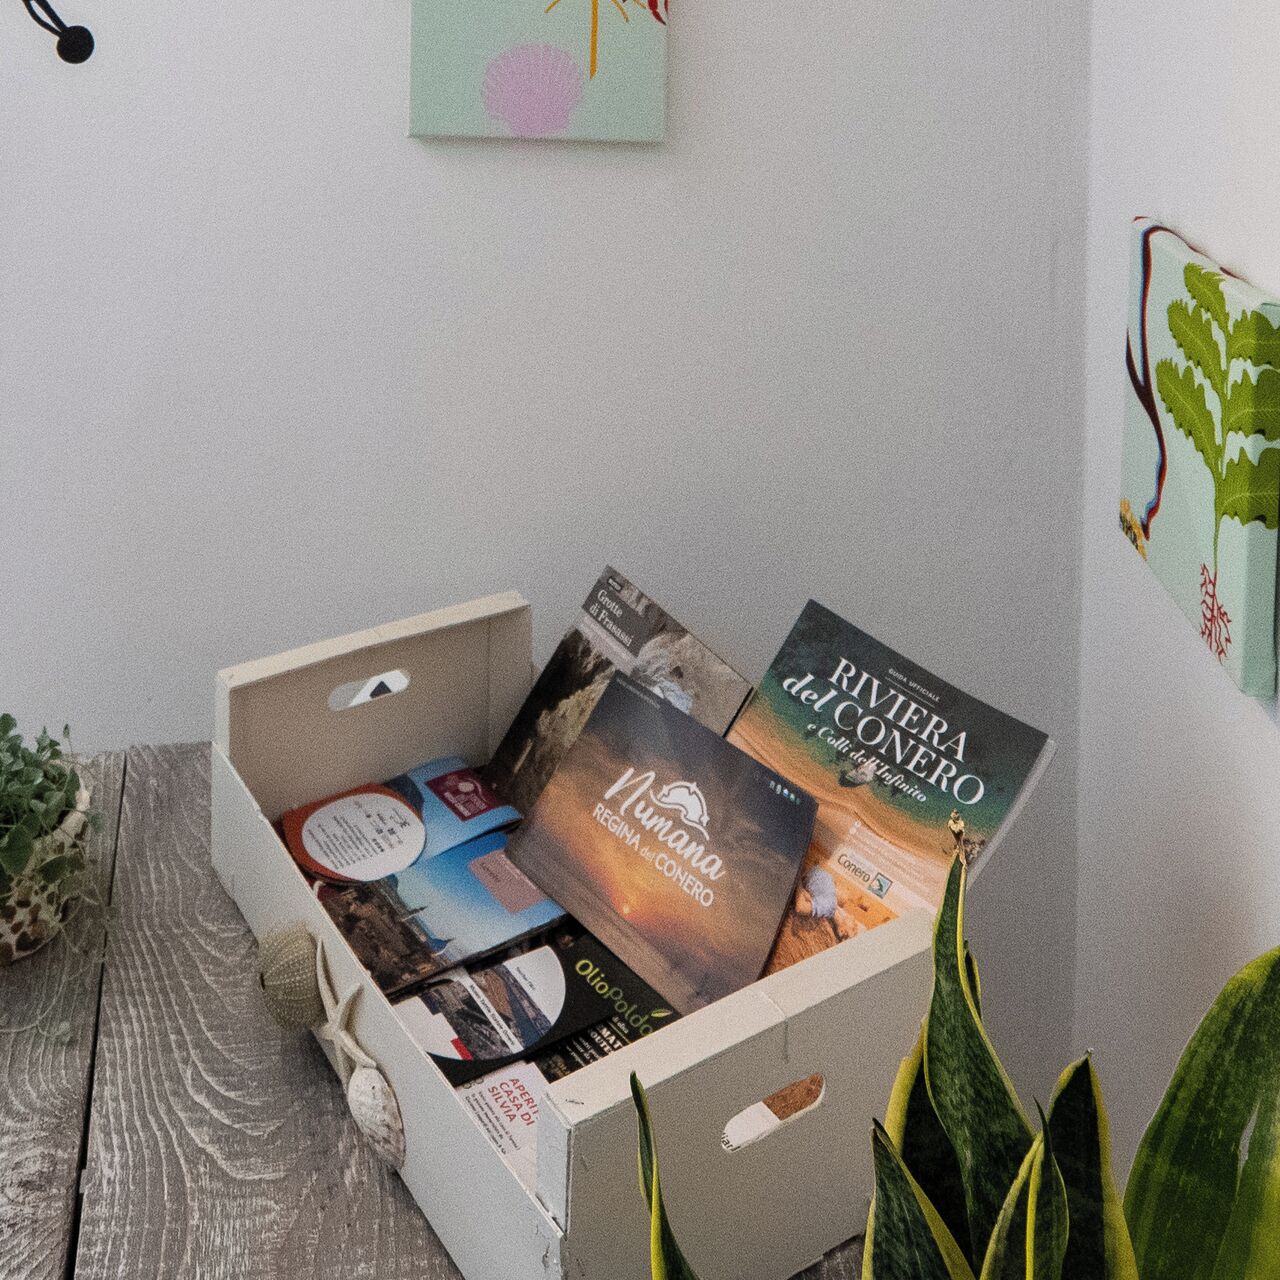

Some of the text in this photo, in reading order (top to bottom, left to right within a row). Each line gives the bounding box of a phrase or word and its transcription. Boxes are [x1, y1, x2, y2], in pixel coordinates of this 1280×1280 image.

[588, 602, 634, 647] di Frasassi
[597, 589, 623, 618] Grotte
[888, 668, 941, 703] GUIDA UFFICIALE
[828, 657, 967, 762] RIVIERA
[782, 672, 838, 713] del
[834, 700, 985, 805] CONERO
[807, 722, 927, 803] e Colli dell'Infinito
[604, 767, 726, 881] Numana
[592, 803, 714, 907] REGINA del CONERO
[837, 853, 871, 883] Conero
[488, 1086, 517, 1122] SILVIA
[499, 1082, 535, 1126] CASA DI
